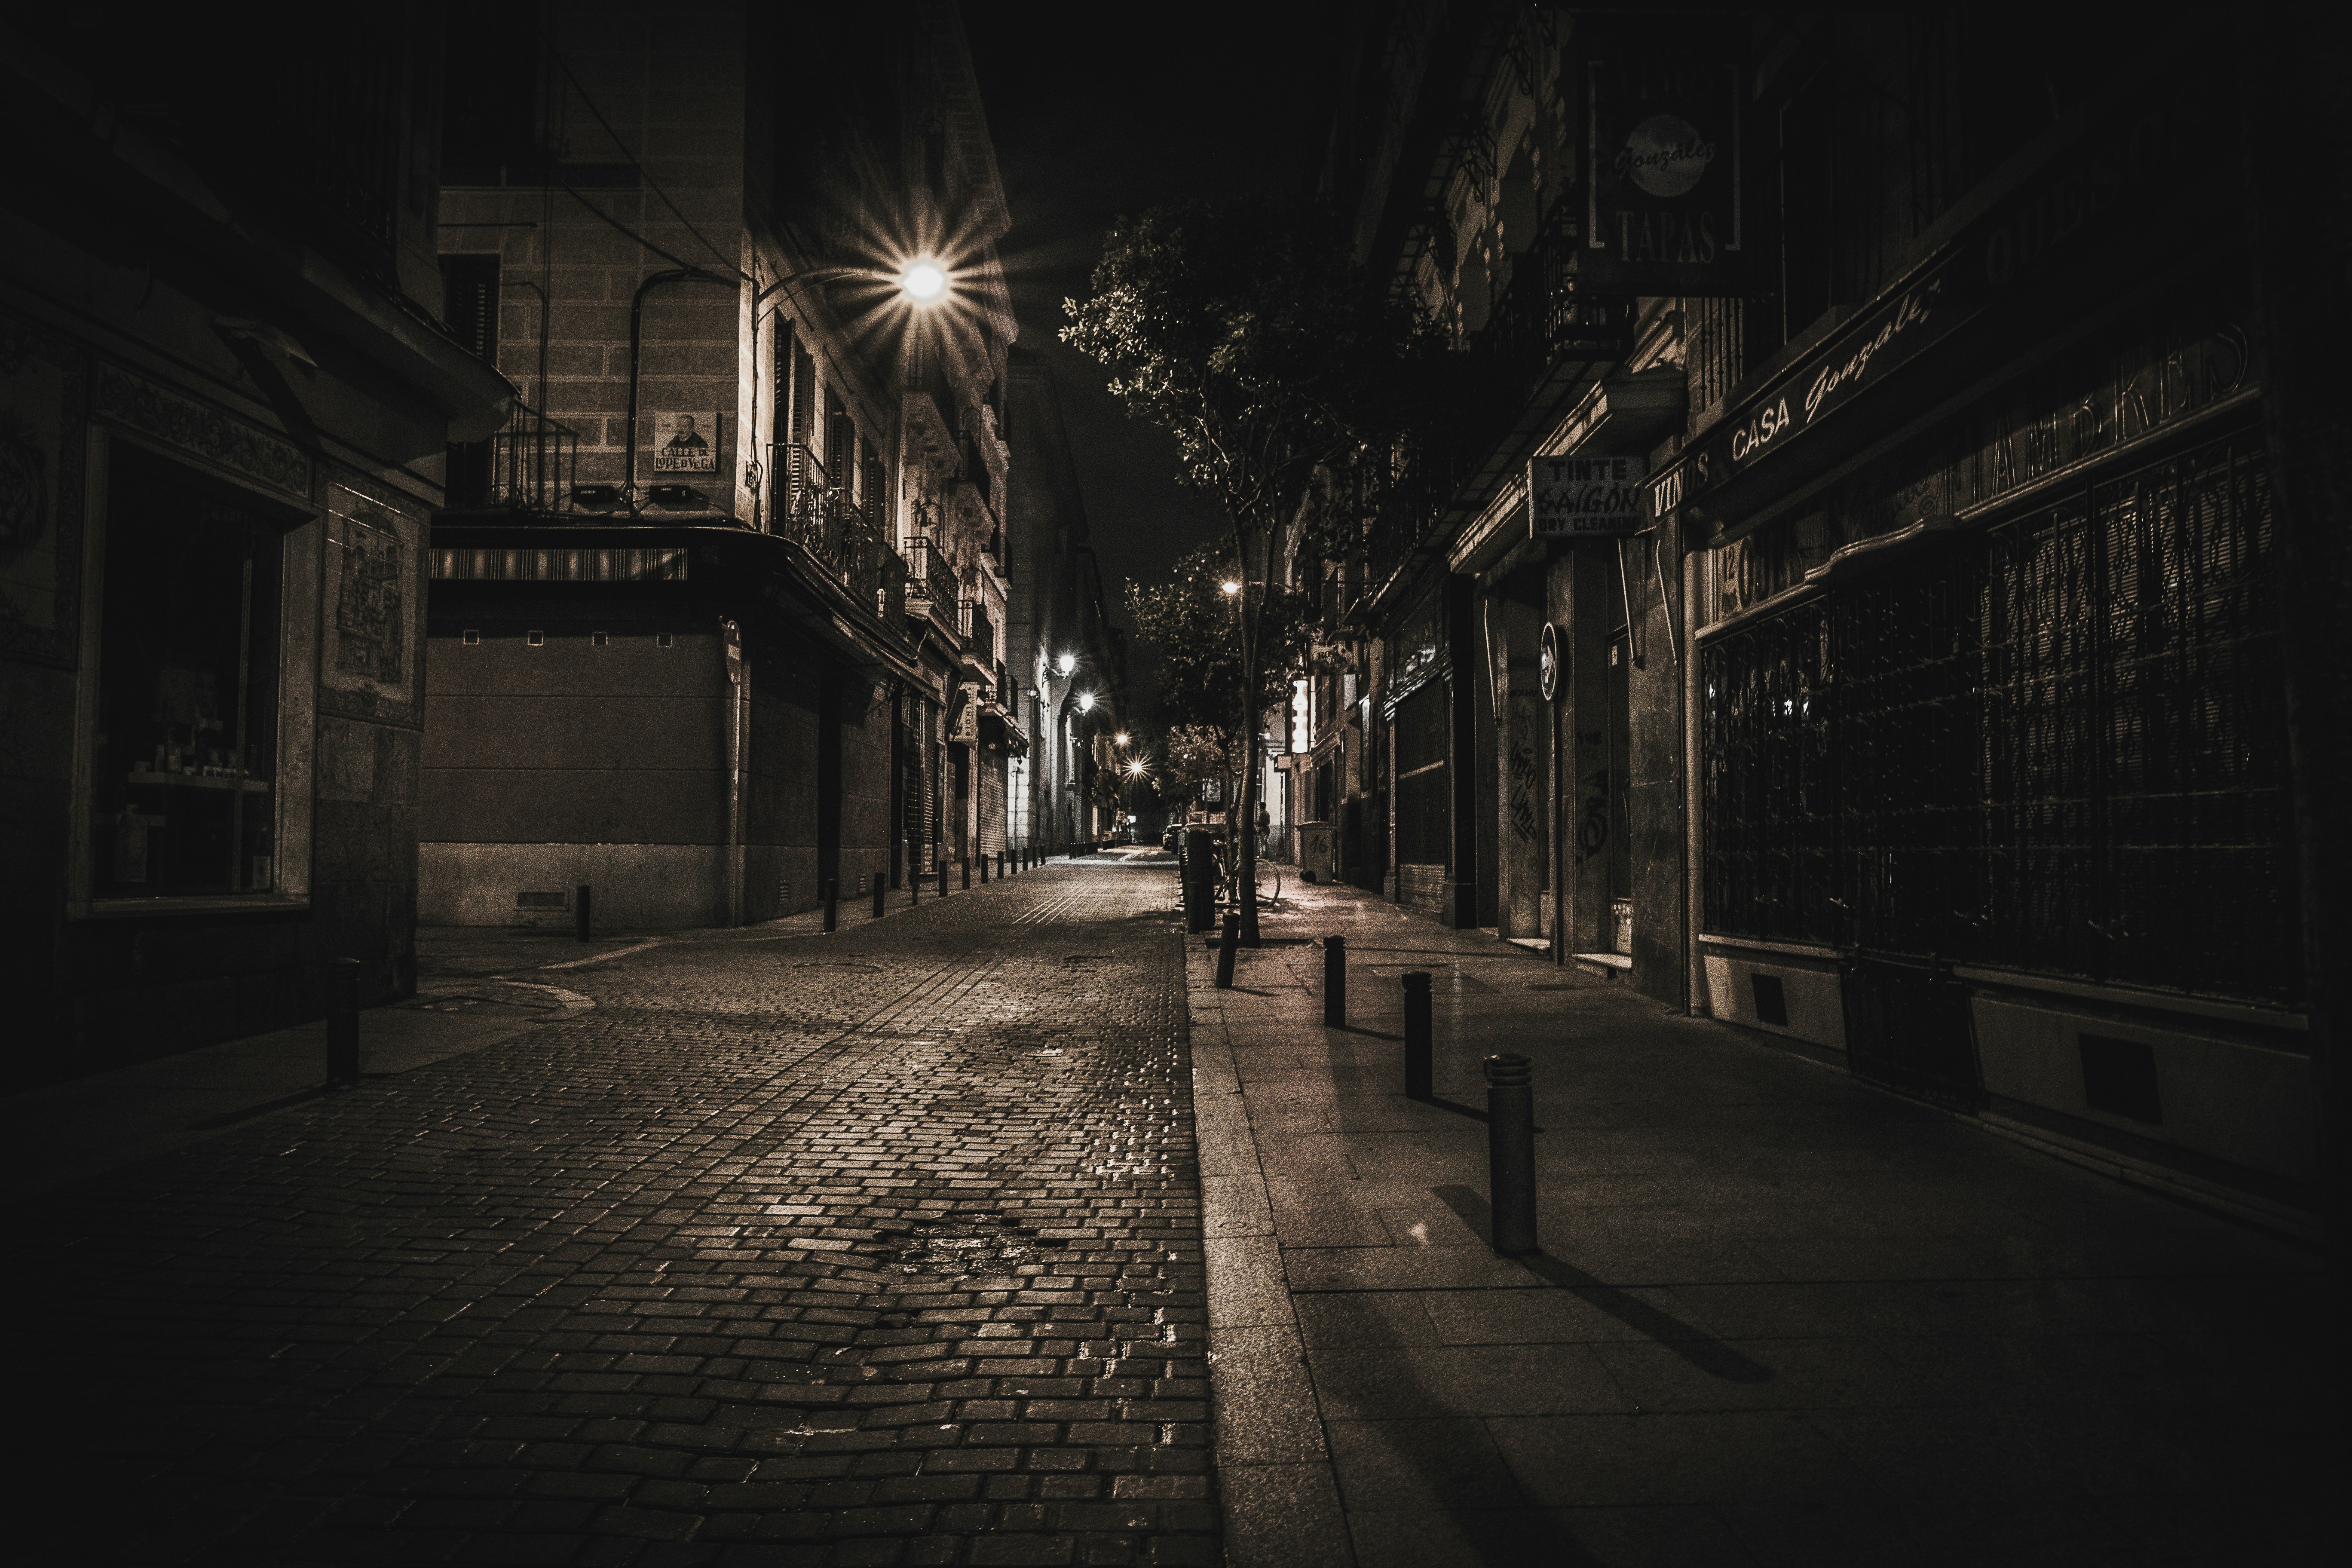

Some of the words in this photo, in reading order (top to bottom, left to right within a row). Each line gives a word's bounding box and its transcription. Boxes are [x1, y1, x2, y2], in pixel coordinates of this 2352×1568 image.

[1617, 46, 1714, 101] VINOS
[1615, 210, 1715, 265] TAPAS
[662, 447, 695, 457] CALLE
[1654, 450, 1709, 518] VINOS
[1732, 396, 1790, 462] CASA
[655, 457, 680, 469] LOPE
[689, 458, 714, 469] VEGA
[1548, 459, 1626, 481] TINTE
[1539, 518, 1565, 532] DRY
[1574, 516, 1641, 532] CLEANING
[1310, 834, 1328, 854] 16
